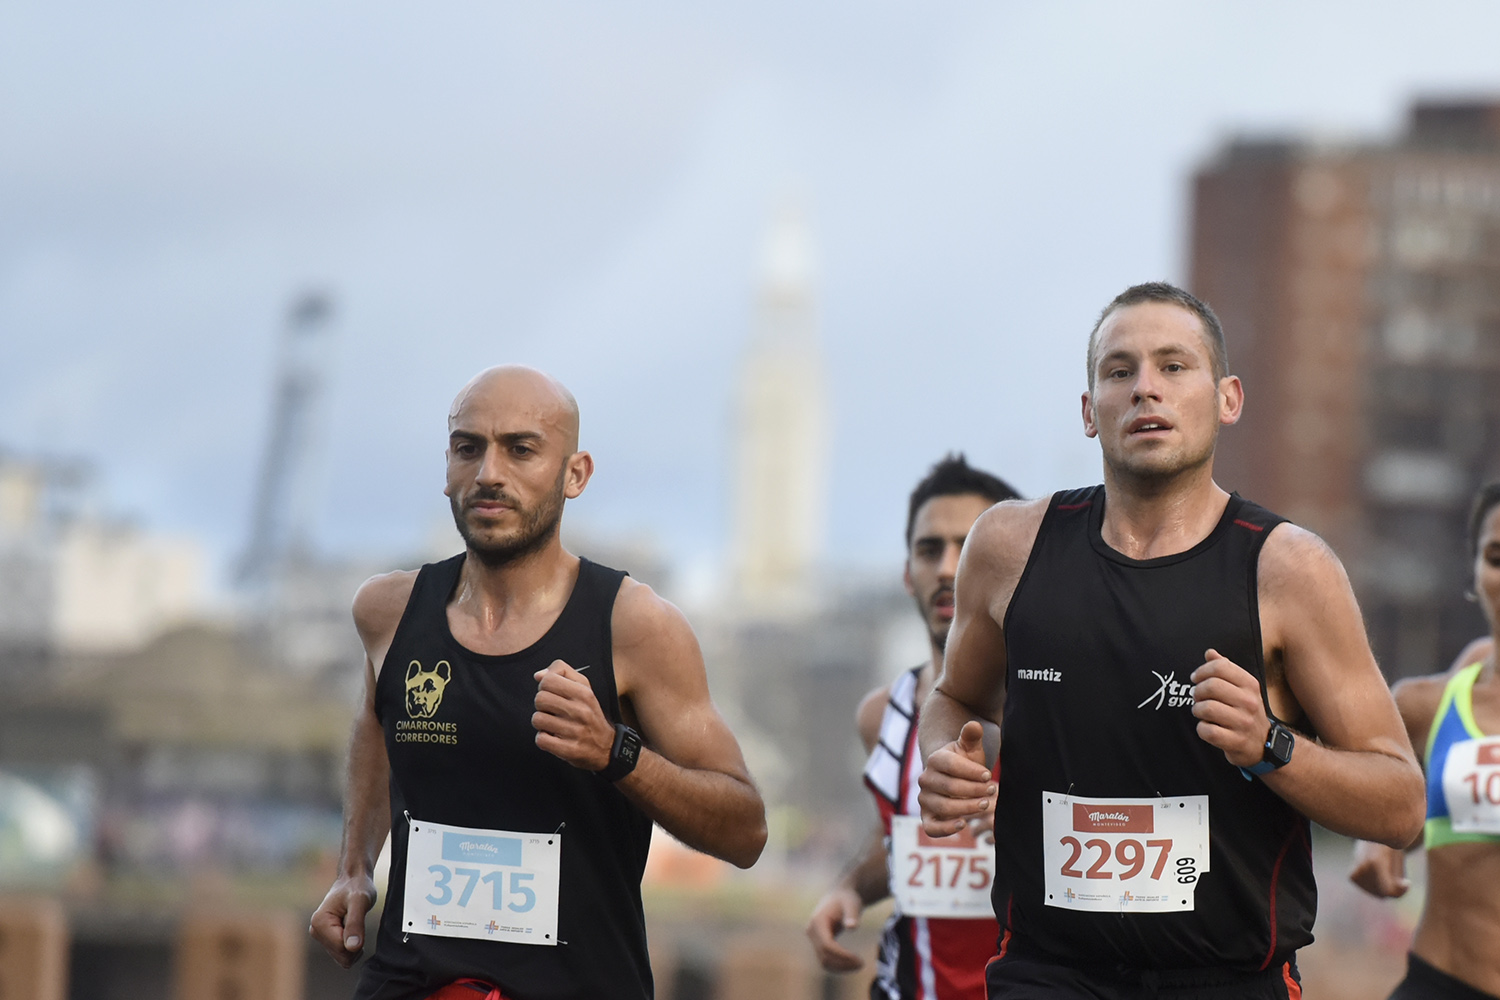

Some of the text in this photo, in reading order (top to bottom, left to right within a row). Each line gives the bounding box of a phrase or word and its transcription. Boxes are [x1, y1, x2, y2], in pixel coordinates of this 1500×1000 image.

[1017, 668, 1062, 682] mantiz
[396, 720, 458, 733] CIMARRONES
[395, 732, 458, 745] CORREDORES
[1088, 810, 1131, 823] Maratón
[1059, 835, 1173, 881] 2297
[907, 852, 991, 891] 2175
[1175, 857, 1197, 884] 609
[425, 864, 537, 914] 3715
